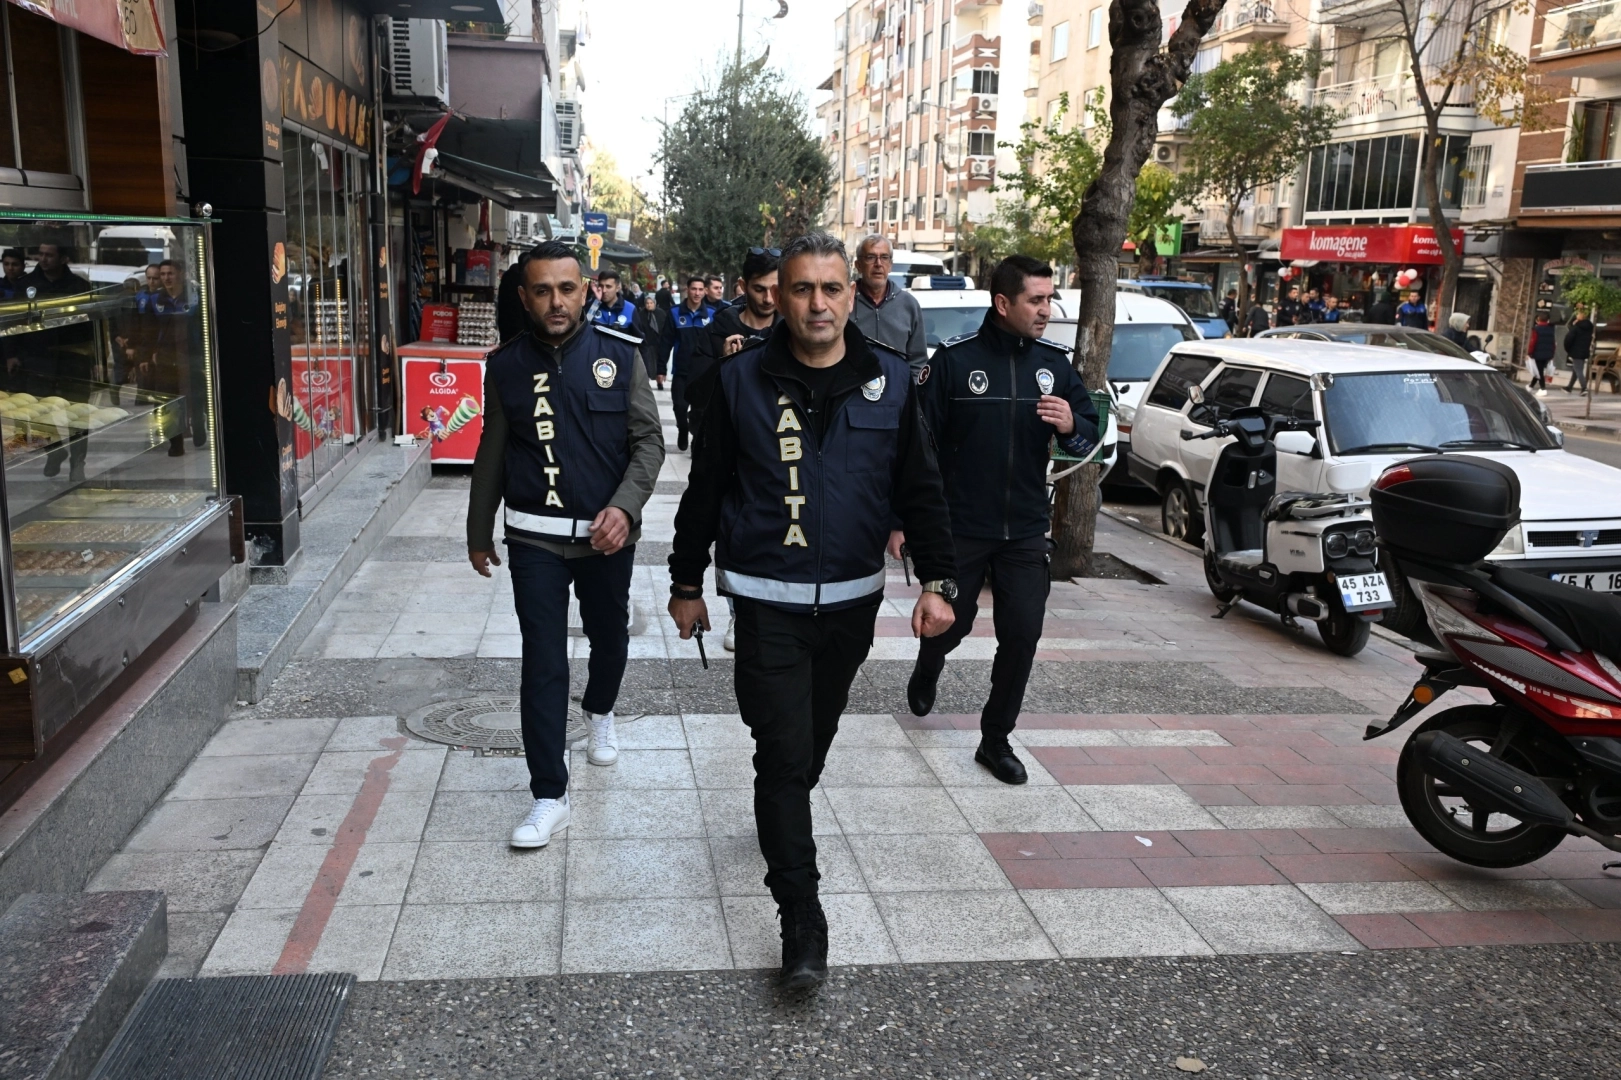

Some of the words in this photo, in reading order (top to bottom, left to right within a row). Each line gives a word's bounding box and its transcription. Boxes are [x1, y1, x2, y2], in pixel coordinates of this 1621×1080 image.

[1309, 231, 1368, 257] komagene
[533, 372, 564, 508] ZABITA
[1342, 578, 1357, 590] 45
[1362, 574, 1385, 588] AZA
[1584, 574, 1595, 590] K
[1356, 589, 1380, 603] 733
